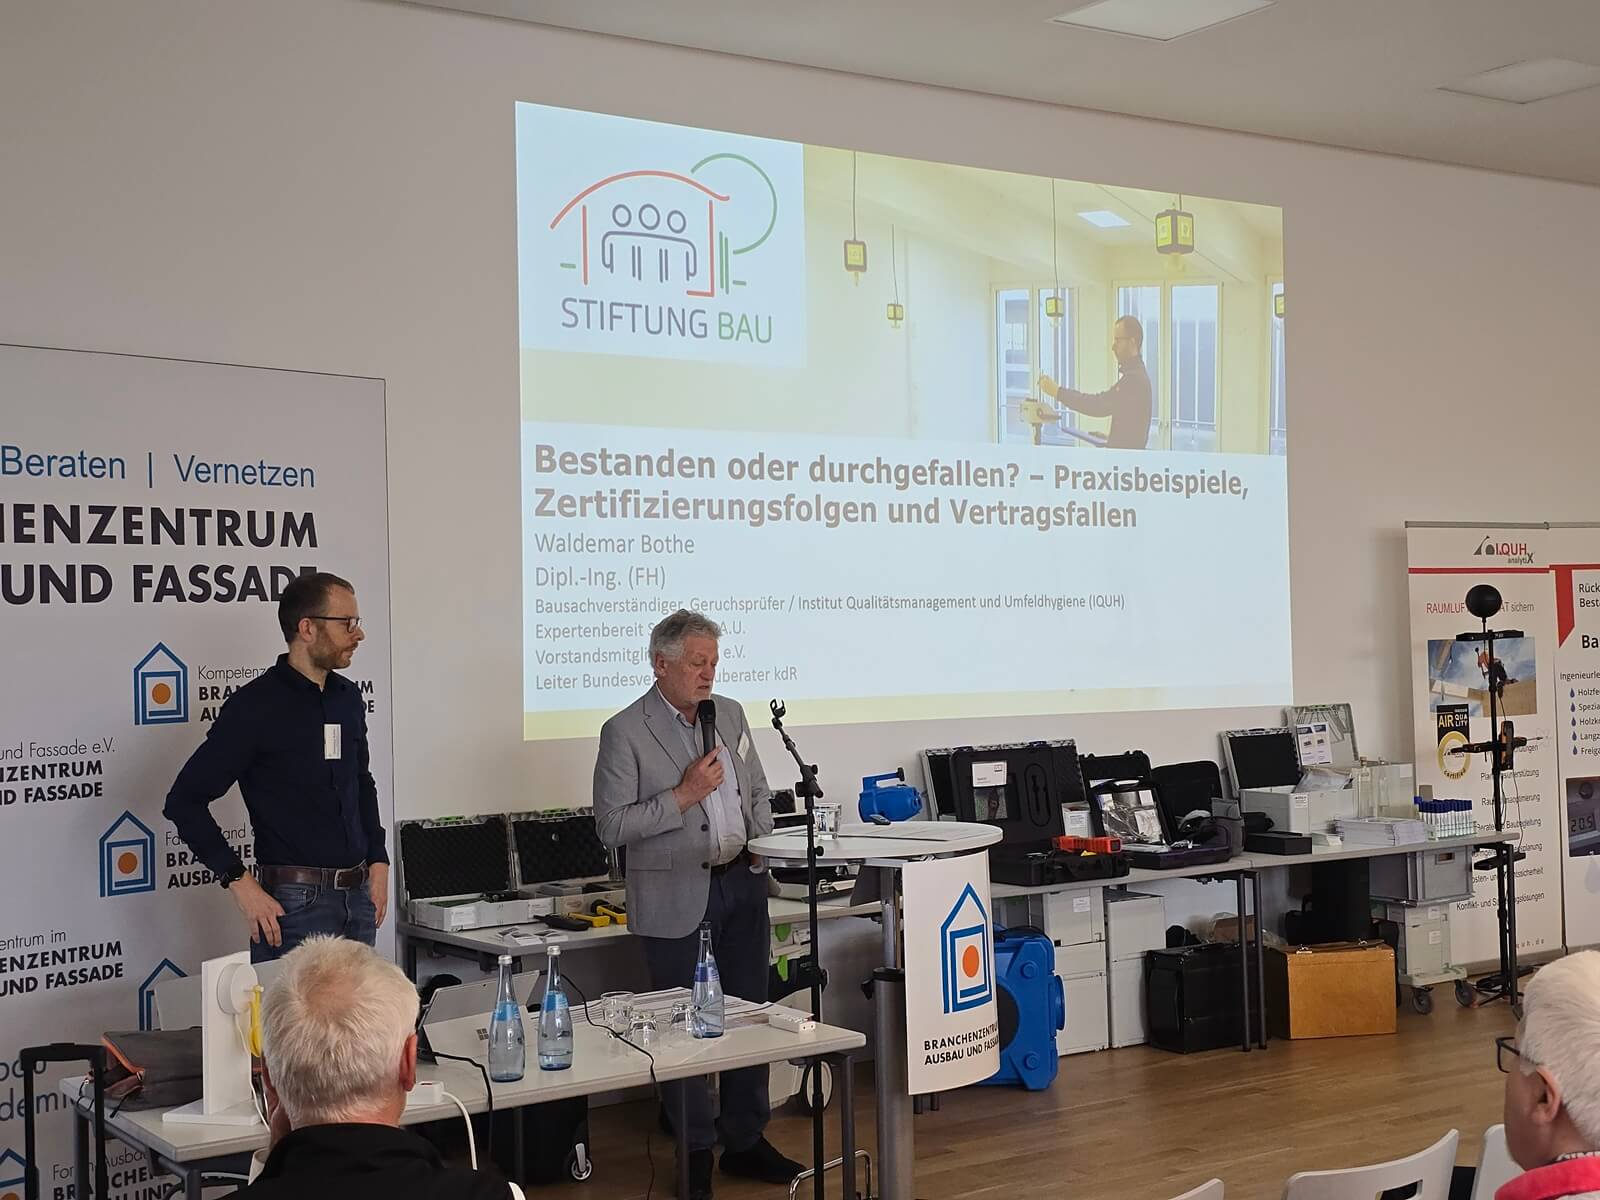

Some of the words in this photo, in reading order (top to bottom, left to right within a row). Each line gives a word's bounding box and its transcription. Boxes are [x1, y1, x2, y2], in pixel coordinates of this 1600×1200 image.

[561, 297, 708, 339] STIFTUNG
[718, 311, 772, 343] BAU
[1, 445, 126, 479] Beraten
[174, 453, 315, 488] Vernetzen
[535, 444, 716, 479] Bestanden
[728, 452, 799, 481] oder
[809, 454, 1020, 491] durchgefallen?
[1055, 464, 1249, 500] Praxisbeispiele,
[534, 487, 877, 528] Zertifizierungsfolgen
[888, 497, 940, 524] und
[950, 499, 1137, 531] Vertragsfallen
[535, 533, 635, 554] Waldemar
[641, 534, 695, 554] Bothe
[1, 564, 113, 605] UND
[133, 564, 317, 603] FASSAD
[535, 566, 622, 591] Dipl.-Ing.
[628, 566, 666, 590] (FH)
[690, 596, 785, 616] Geruchsprüfer
[799, 595, 843, 610] Institut
[847, 594, 977, 612] Qualitätsmanagement
[979, 594, 1001, 609] und
[1004, 594, 1086, 611] Umfeldhygiene
[1088, 593, 1126, 611] (IQUH)
[536, 646, 650, 666] Vorstandsmitgli
[536, 673, 578, 690] Leiter
[583, 671, 654, 688] Bundesve
[715, 668, 771, 684] uberater
[773, 665, 799, 681] kdR
[1438, 713, 1455, 728] AIR
[1454, 713, 1468, 721] QUA
[29, 738, 87, 758] Fassade
[92, 736, 116, 754] e.V.
[0, 760, 103, 783] ZENTRUM
[24, 782, 103, 803] FASSADE
[51, 929, 66, 944] im
[46, 962, 123, 990] FASSADE
[924, 1048, 964, 1066] AUSBAU
[966, 1043, 983, 1057] UND
